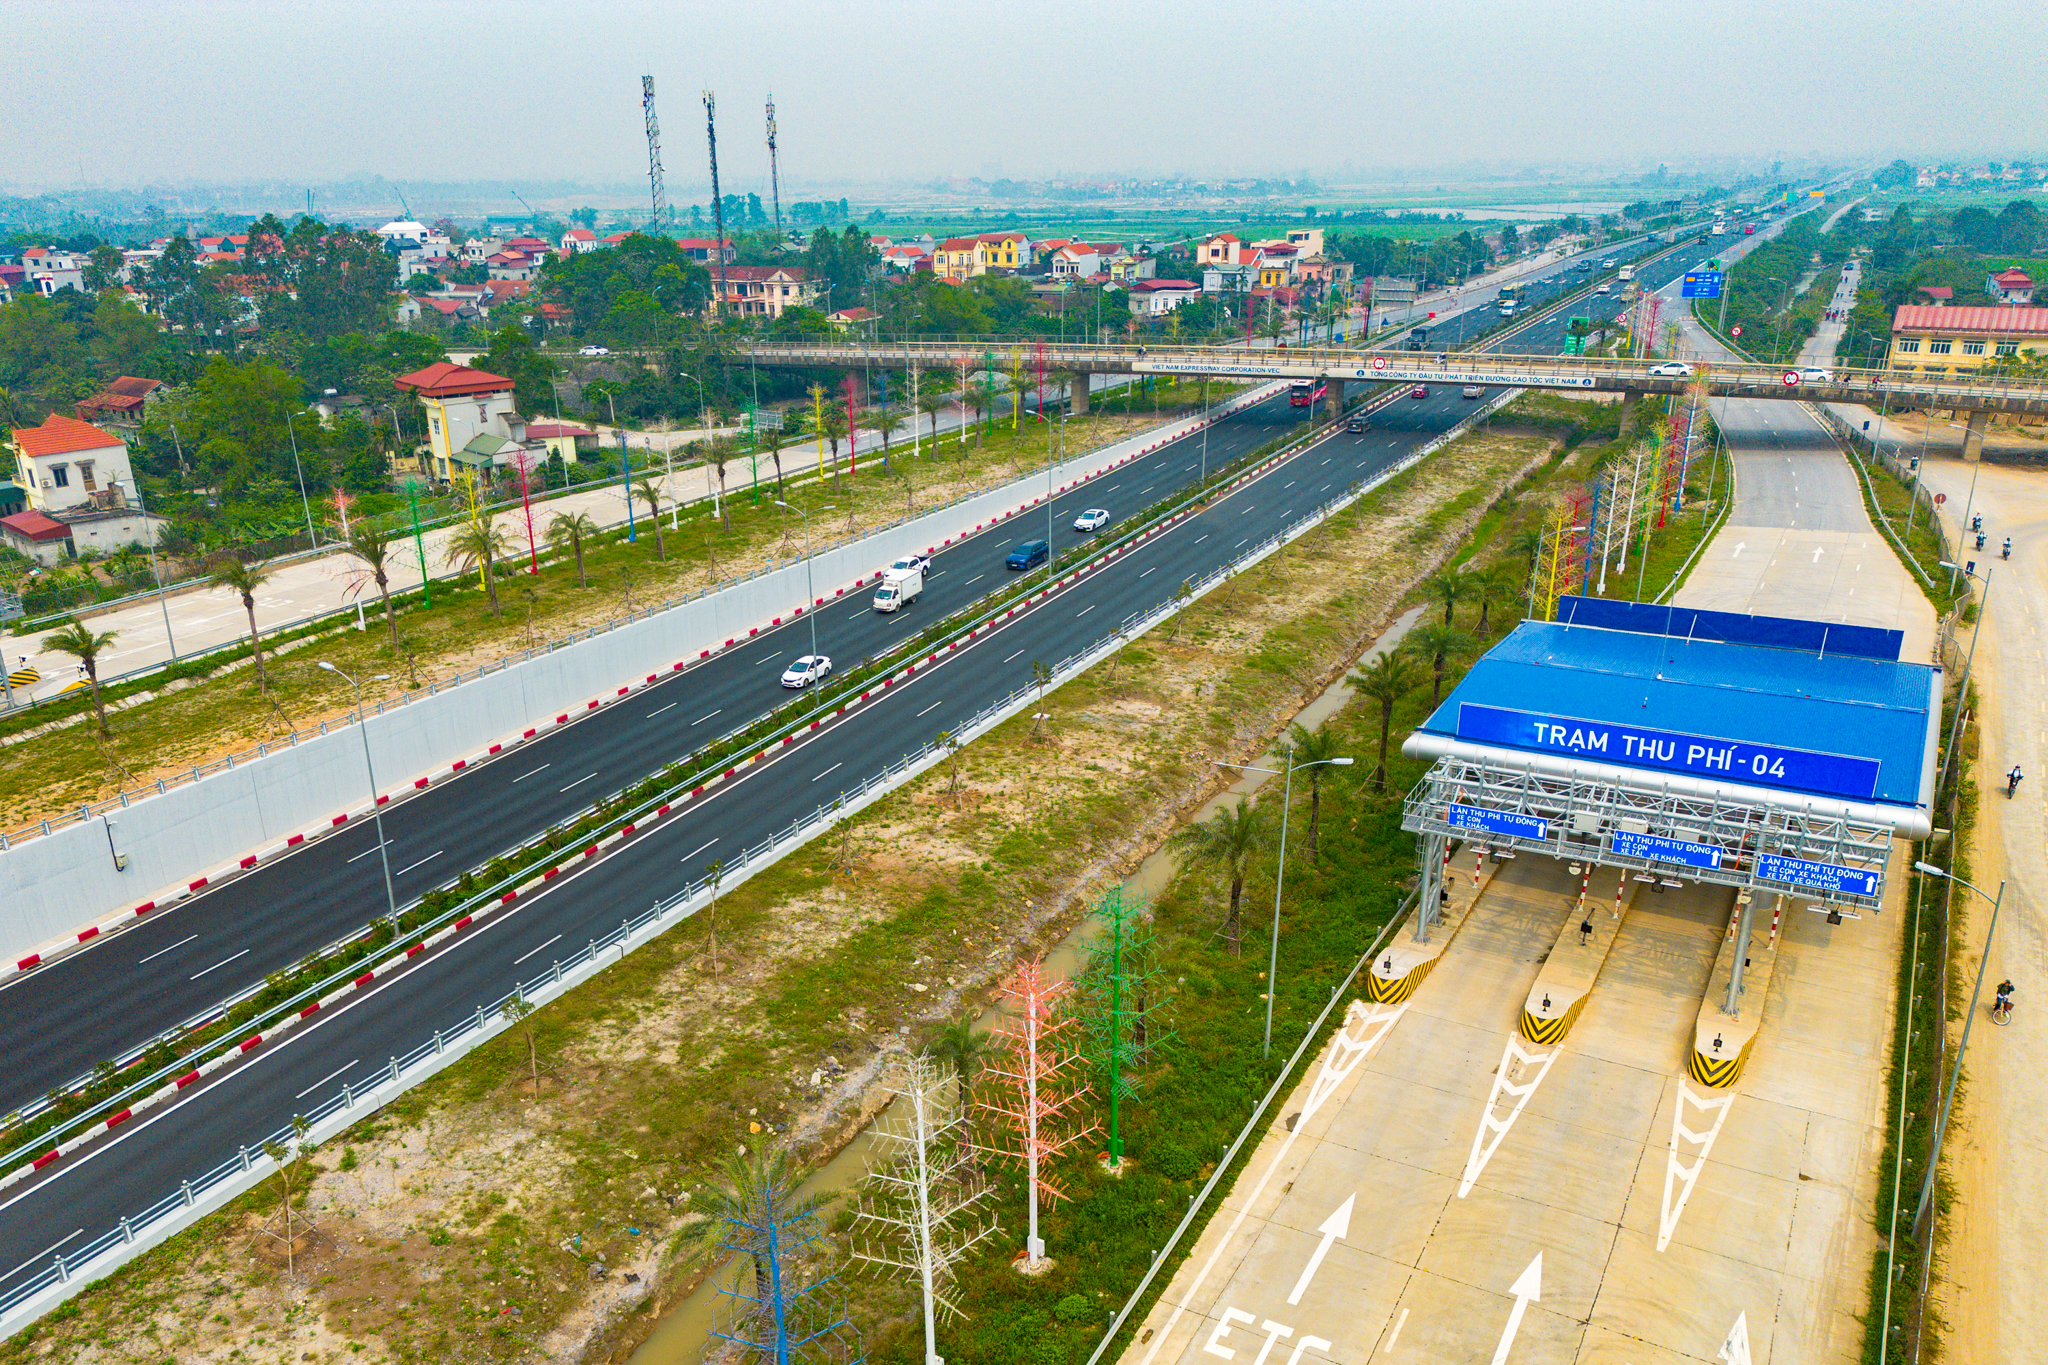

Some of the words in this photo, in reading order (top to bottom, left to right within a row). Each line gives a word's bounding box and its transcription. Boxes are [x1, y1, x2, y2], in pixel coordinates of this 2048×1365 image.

[1533, 722, 1609, 752] TRẠM
[1622, 735, 1675, 761] THU
[1451, 806, 1468, 815] LÀN
[1470, 809, 1486, 817] THU
[1488, 812, 1500, 820] PHÍ
[1503, 814, 1515, 823] TỰ
[1515, 816, 1537, 827] ĐỘNG
[1466, 821, 1489, 830] KHÁCH
[1615, 833, 1634, 842] LÀN
[1636, 836, 1654, 845] THU
[1672, 842, 1684, 852] TỰ
[1686, 845, 1711, 855] ĐỘNG
[1661, 854, 1687, 864] KHÁCH
[1761, 855, 1781, 866] LÀN
[1783, 859, 1802, 869] THU
[1804, 863, 1821, 872] PHÍ
[1822, 866, 1836, 877] TỰ
[1837, 869, 1863, 880] ĐỘNG
[1794, 876, 1804, 884] XE
[1203, 1306, 1332, 1365] ETC
